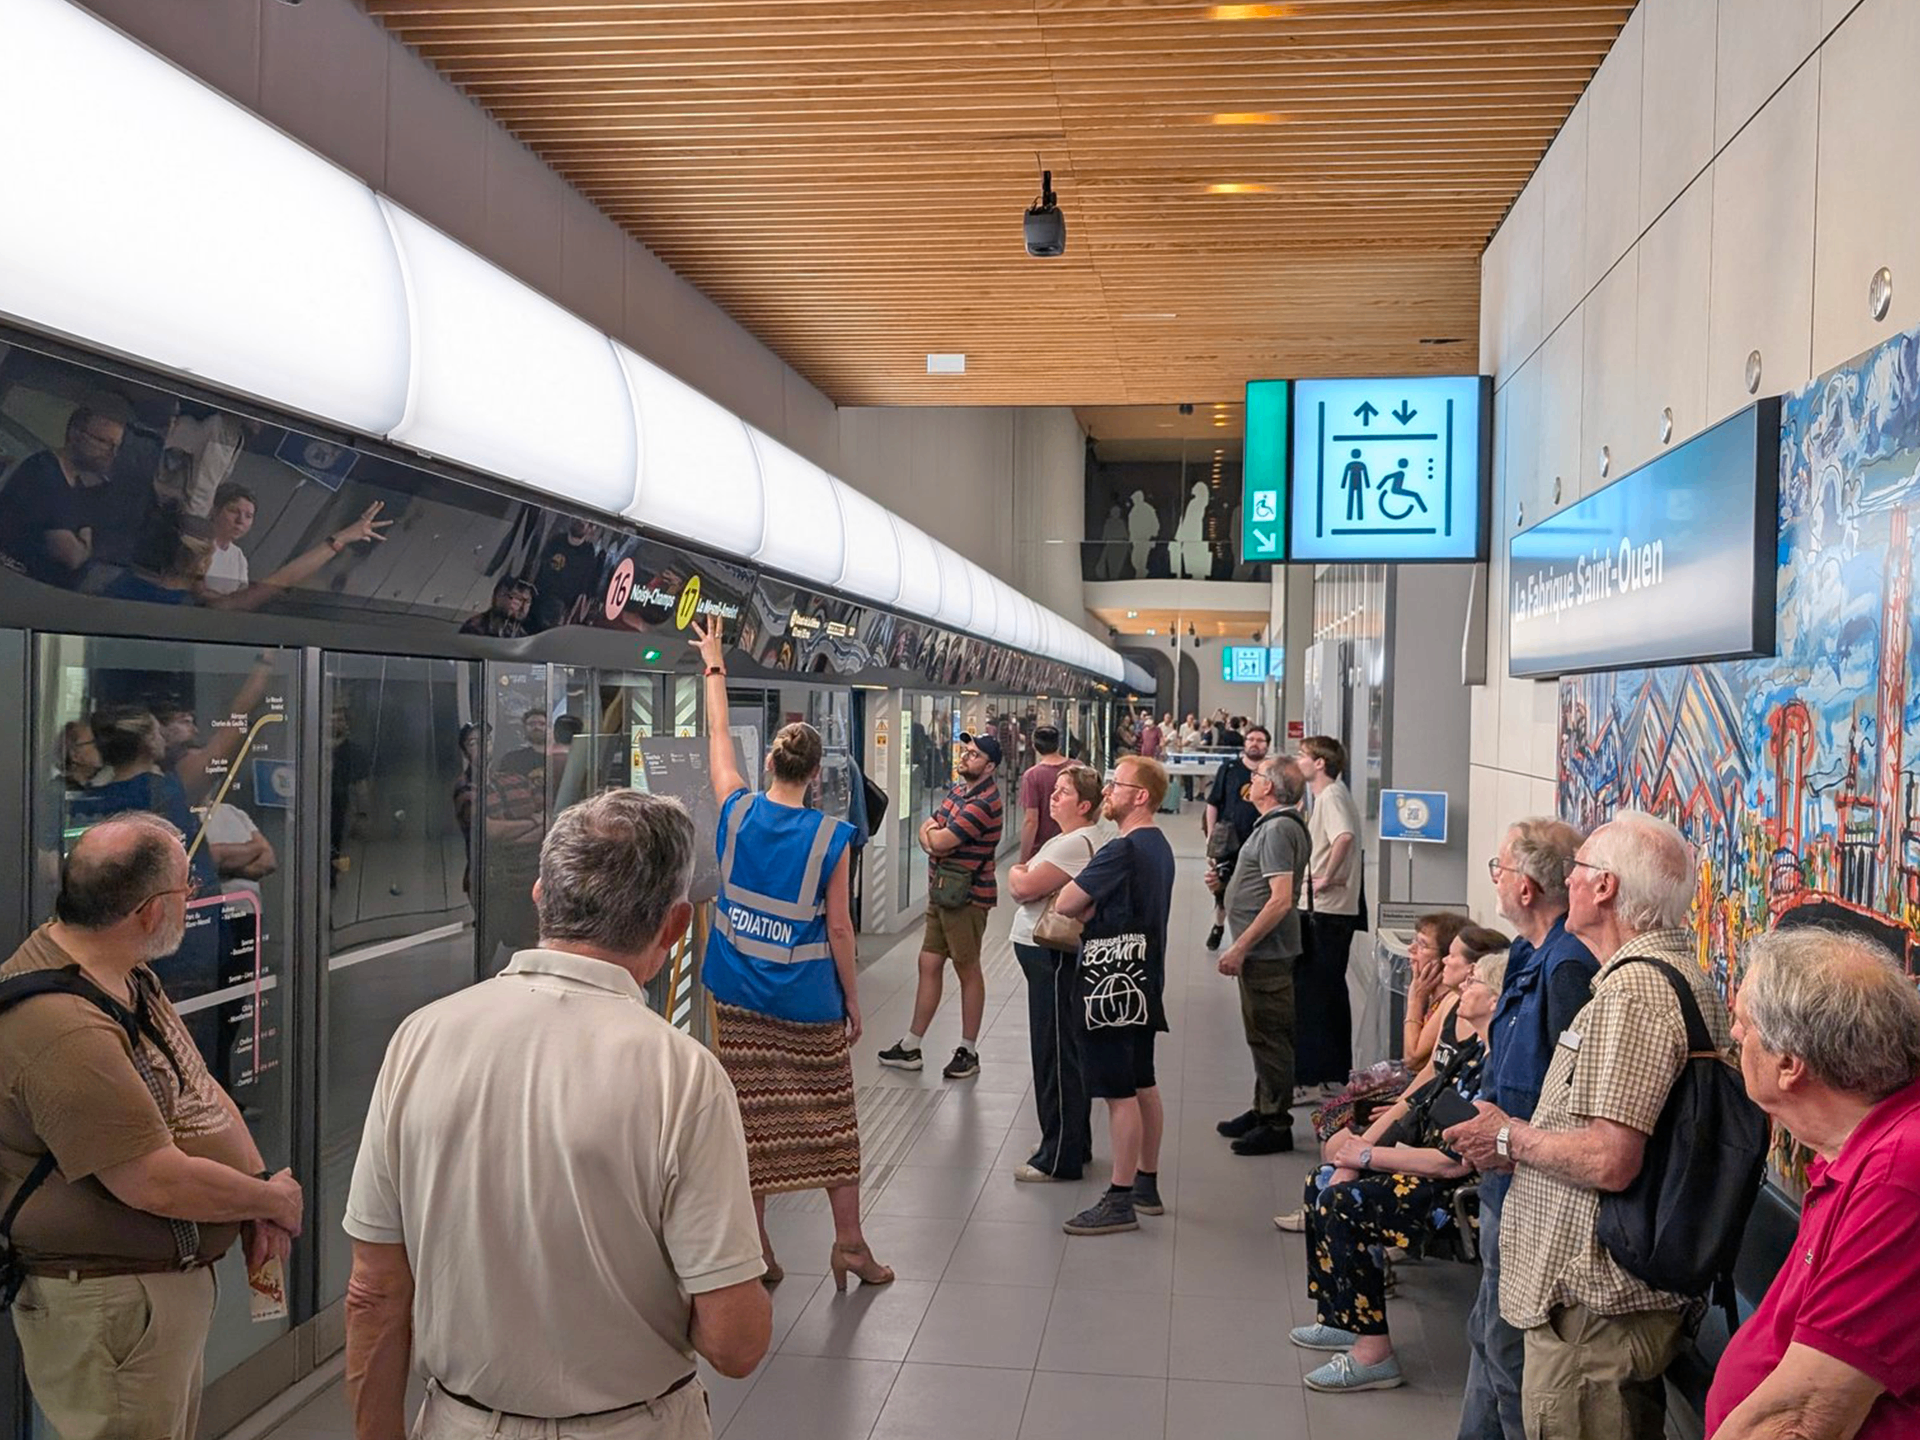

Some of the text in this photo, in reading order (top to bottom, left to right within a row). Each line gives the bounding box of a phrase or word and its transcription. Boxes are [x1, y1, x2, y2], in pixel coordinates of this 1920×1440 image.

[610, 572, 631, 607] 16
[630, 583, 676, 611] Noisy-Champs
[1515, 536, 1664, 624] La Fabrique Saint-Ouen
[680, 587, 698, 618] 17
[728, 906, 793, 944] EDIATION
